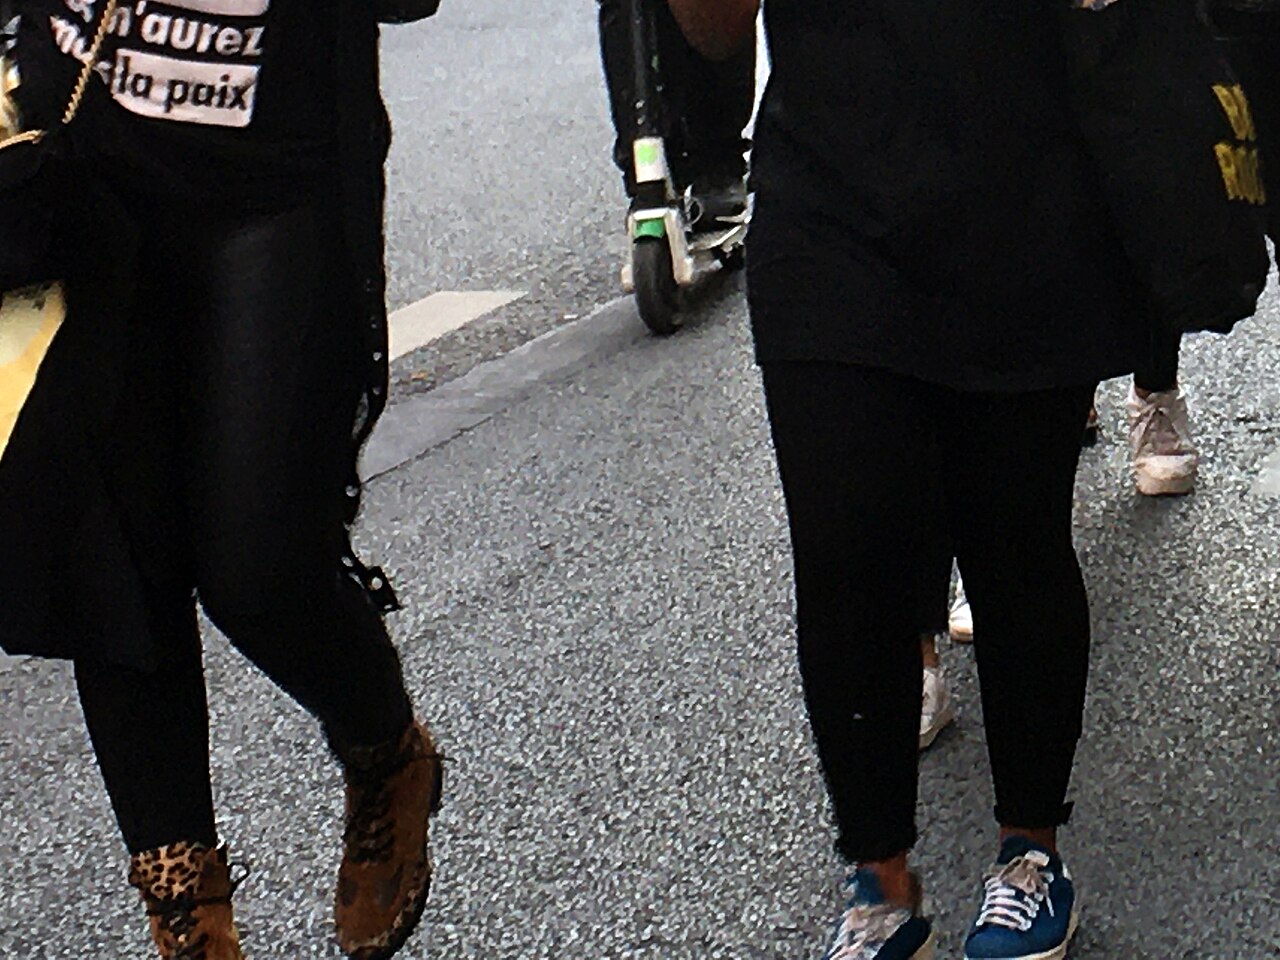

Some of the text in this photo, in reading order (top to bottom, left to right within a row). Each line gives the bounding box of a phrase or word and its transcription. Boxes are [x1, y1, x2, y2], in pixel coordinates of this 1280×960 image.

[107, 1, 266, 57] n'aurez
[119, 55, 252, 114] la paix
